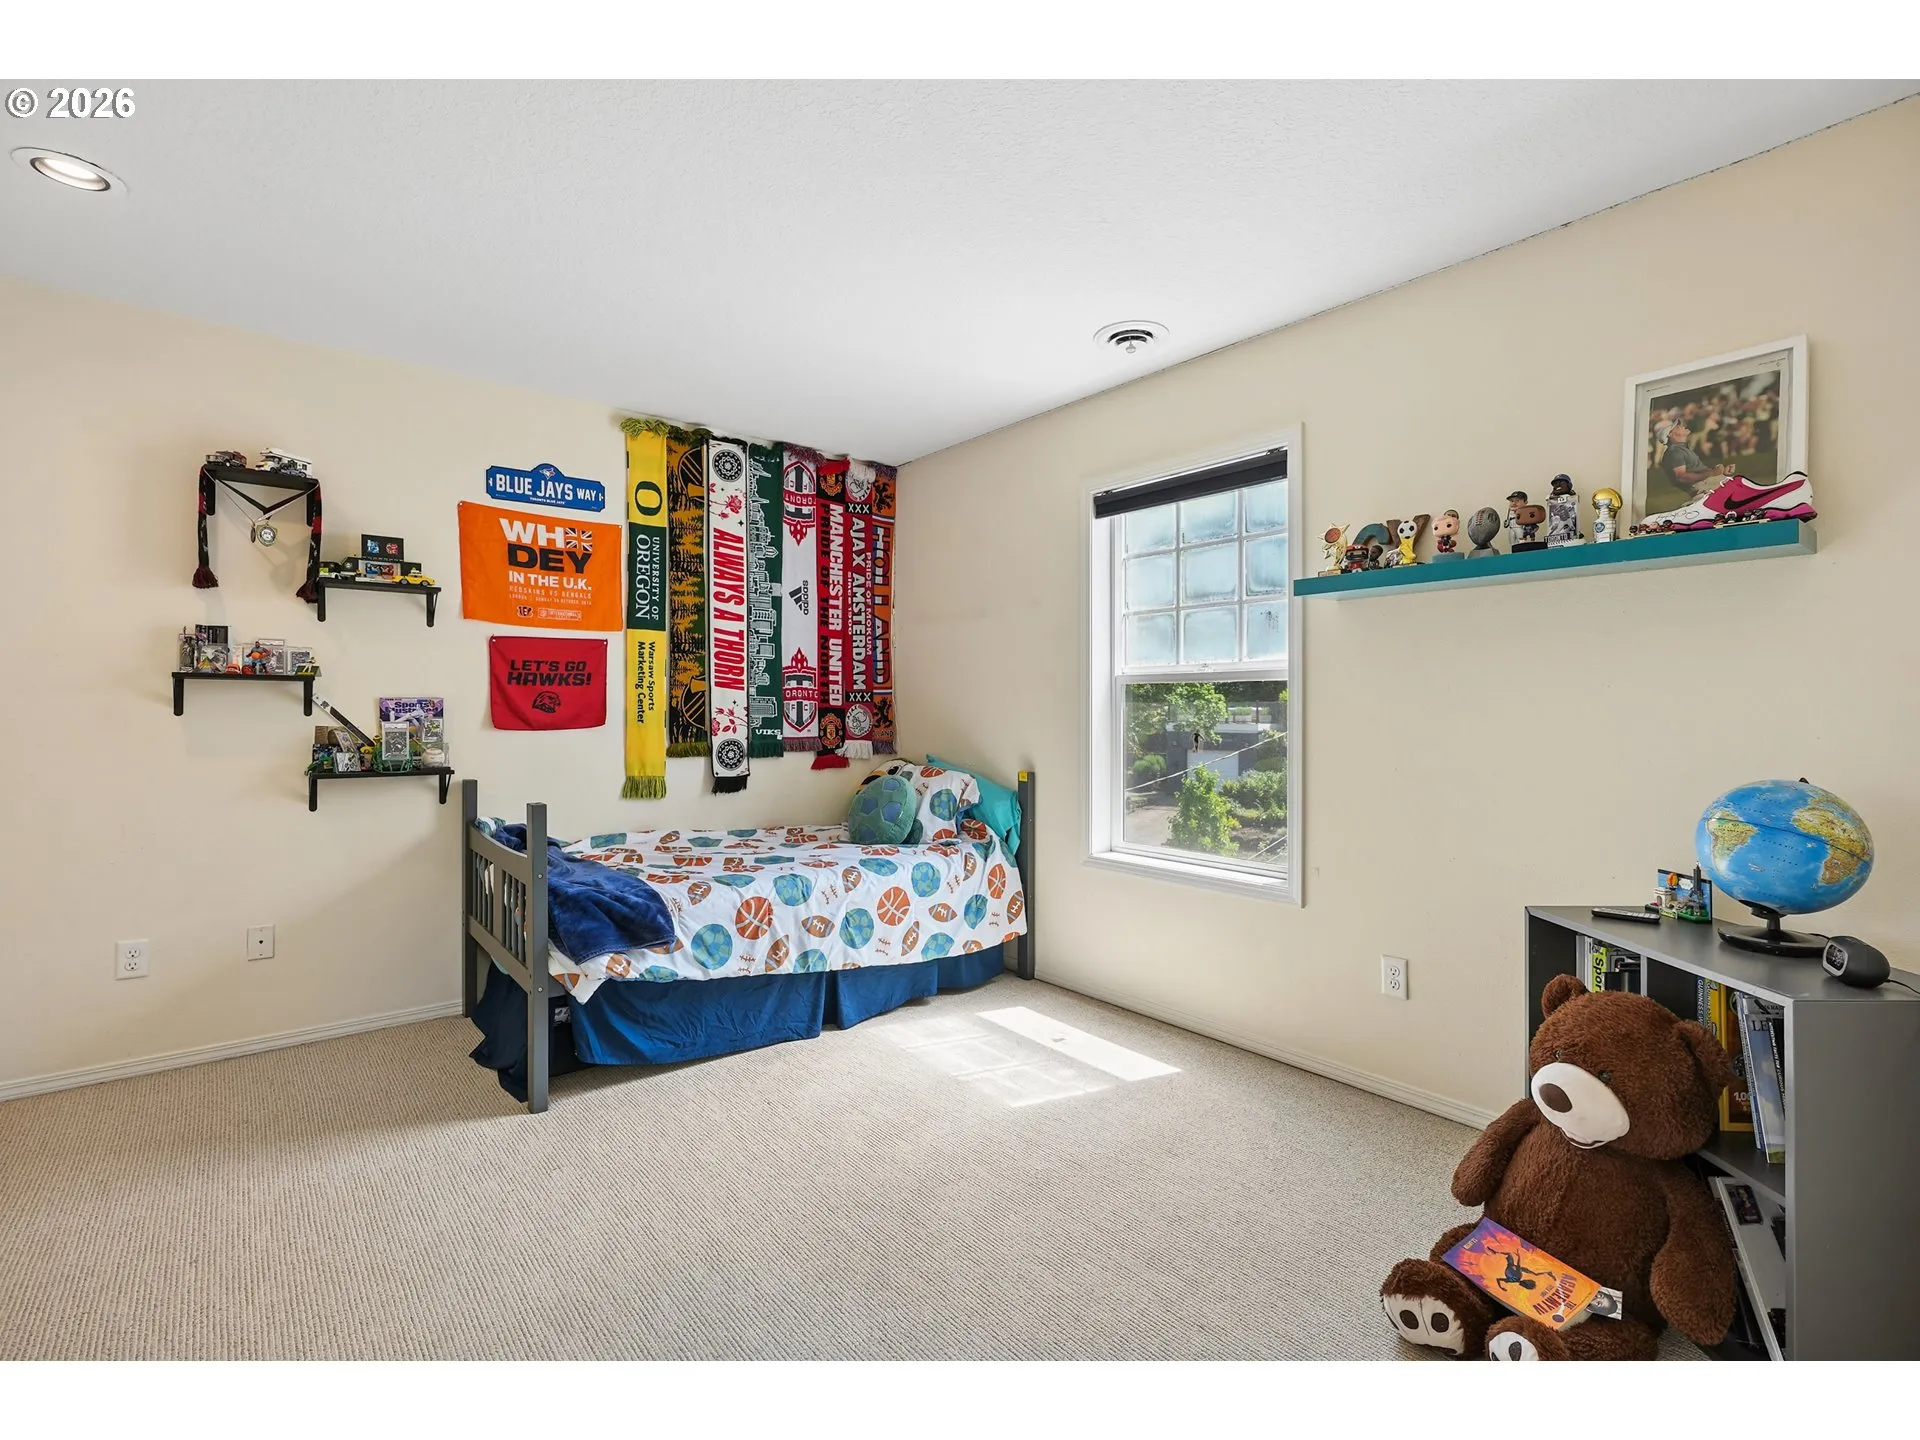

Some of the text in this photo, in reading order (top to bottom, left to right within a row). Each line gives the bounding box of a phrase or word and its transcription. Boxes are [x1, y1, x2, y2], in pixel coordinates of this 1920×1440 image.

[496, 473, 597, 502] BLUE JAYS WAY
[635, 481, 663, 516] O
[508, 543, 593, 574] DEY
[508, 570, 592, 591] IN THE U.K.
[635, 534, 651, 620] OREGON
[651, 536, 660, 620] UNIVERSITY OF
[829, 503, 844, 631] MANCHESTER
[561, 591, 592, 599] BENGALS
[713, 527, 745, 692] ALWAYS A THORN
[819, 503, 830, 704] PRIDE OF THE NORTH
[849, 516, 867, 690] AJAX AMSTERDAM
[866, 590, 872, 605] OF
[872, 525, 891, 685] HOLLAND
[507, 672, 592, 686] HAWKS!
[510, 660, 587, 672] LET'S GO
[635, 641, 647, 724] Marketing Center
[646, 641, 656, 711] Warsaw Sports
[829, 638, 843, 706] UNITED
[1593, 957, 1604, 992] Spor
